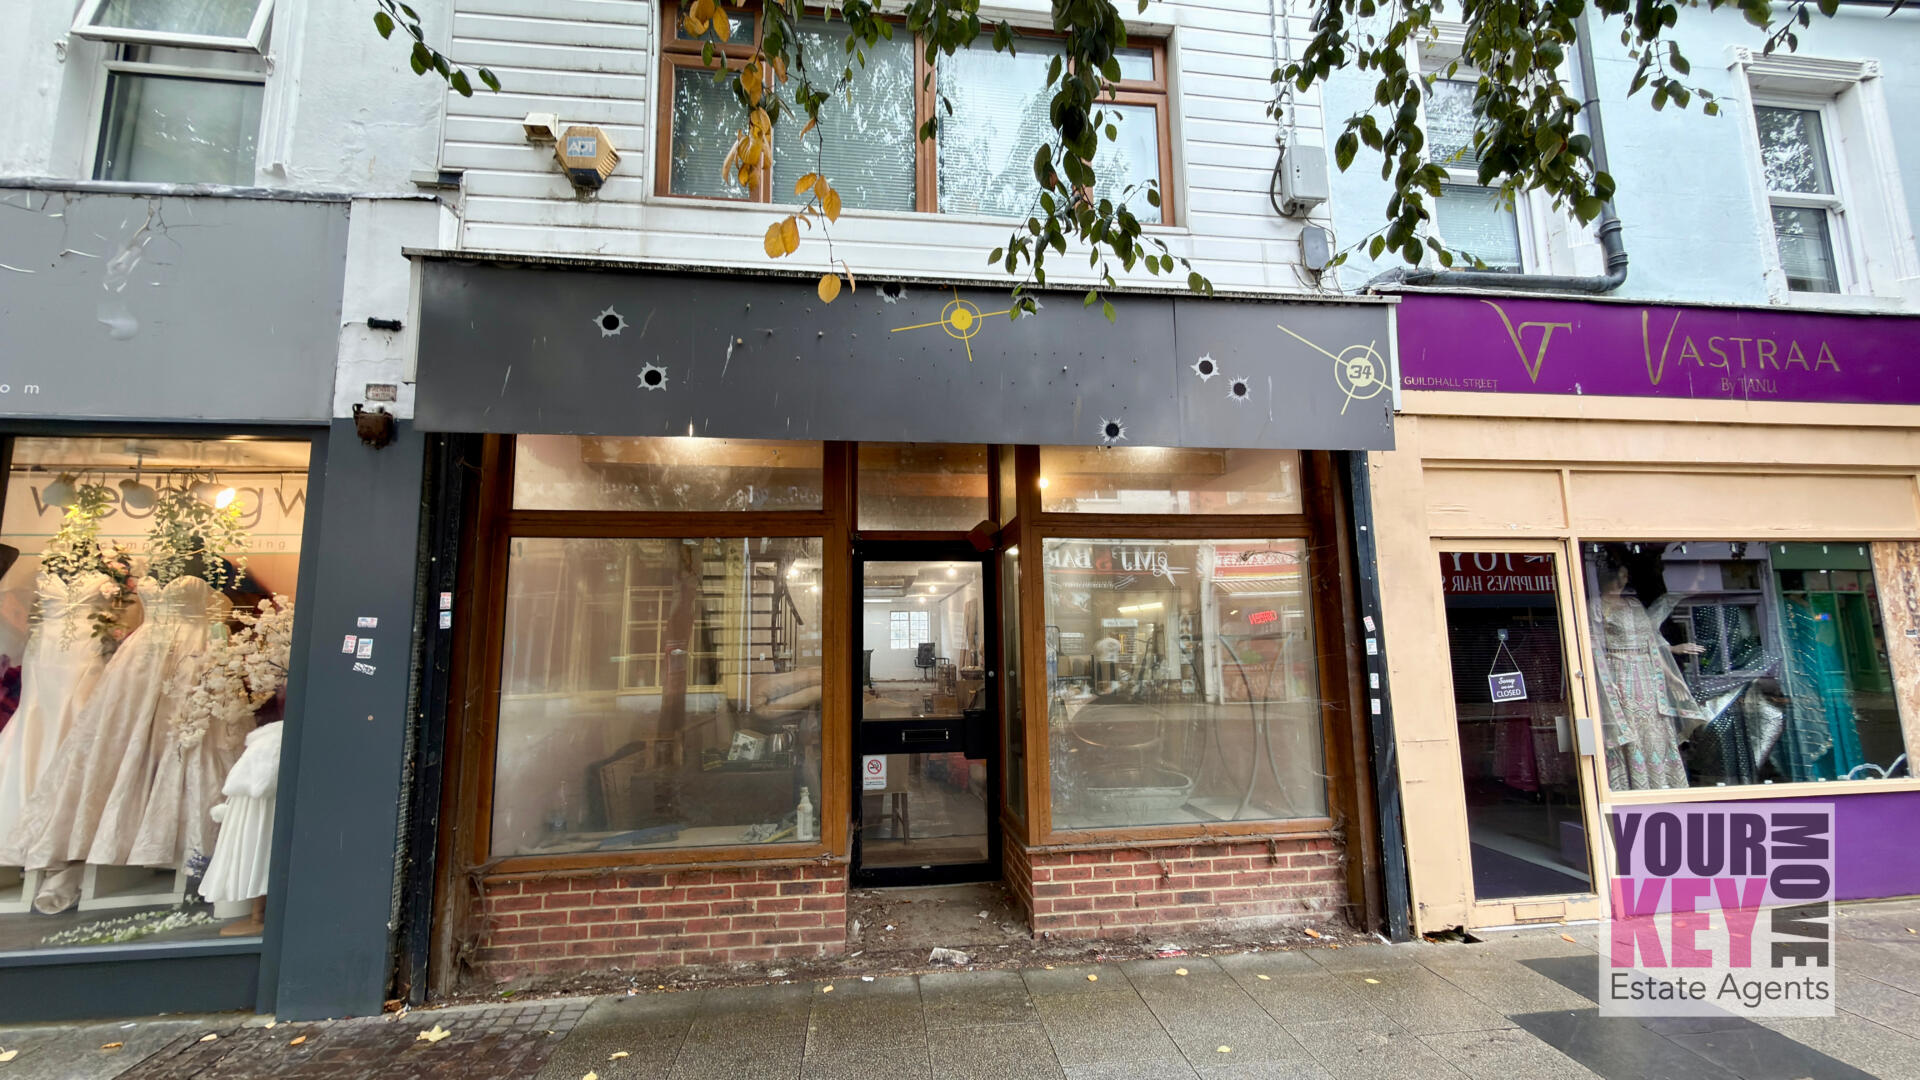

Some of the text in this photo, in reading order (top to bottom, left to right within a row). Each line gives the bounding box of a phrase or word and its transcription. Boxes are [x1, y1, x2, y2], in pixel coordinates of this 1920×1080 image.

[568, 141, 595, 153] ADT
[1642, 310, 1841, 385] VASTRAA
[1349, 365, 1372, 379] 34
[1404, 376, 1498, 389] GUILDHALL STREET
[1737, 377, 1778, 393] TANU
[1496, 689, 1521, 698] CLOSED
